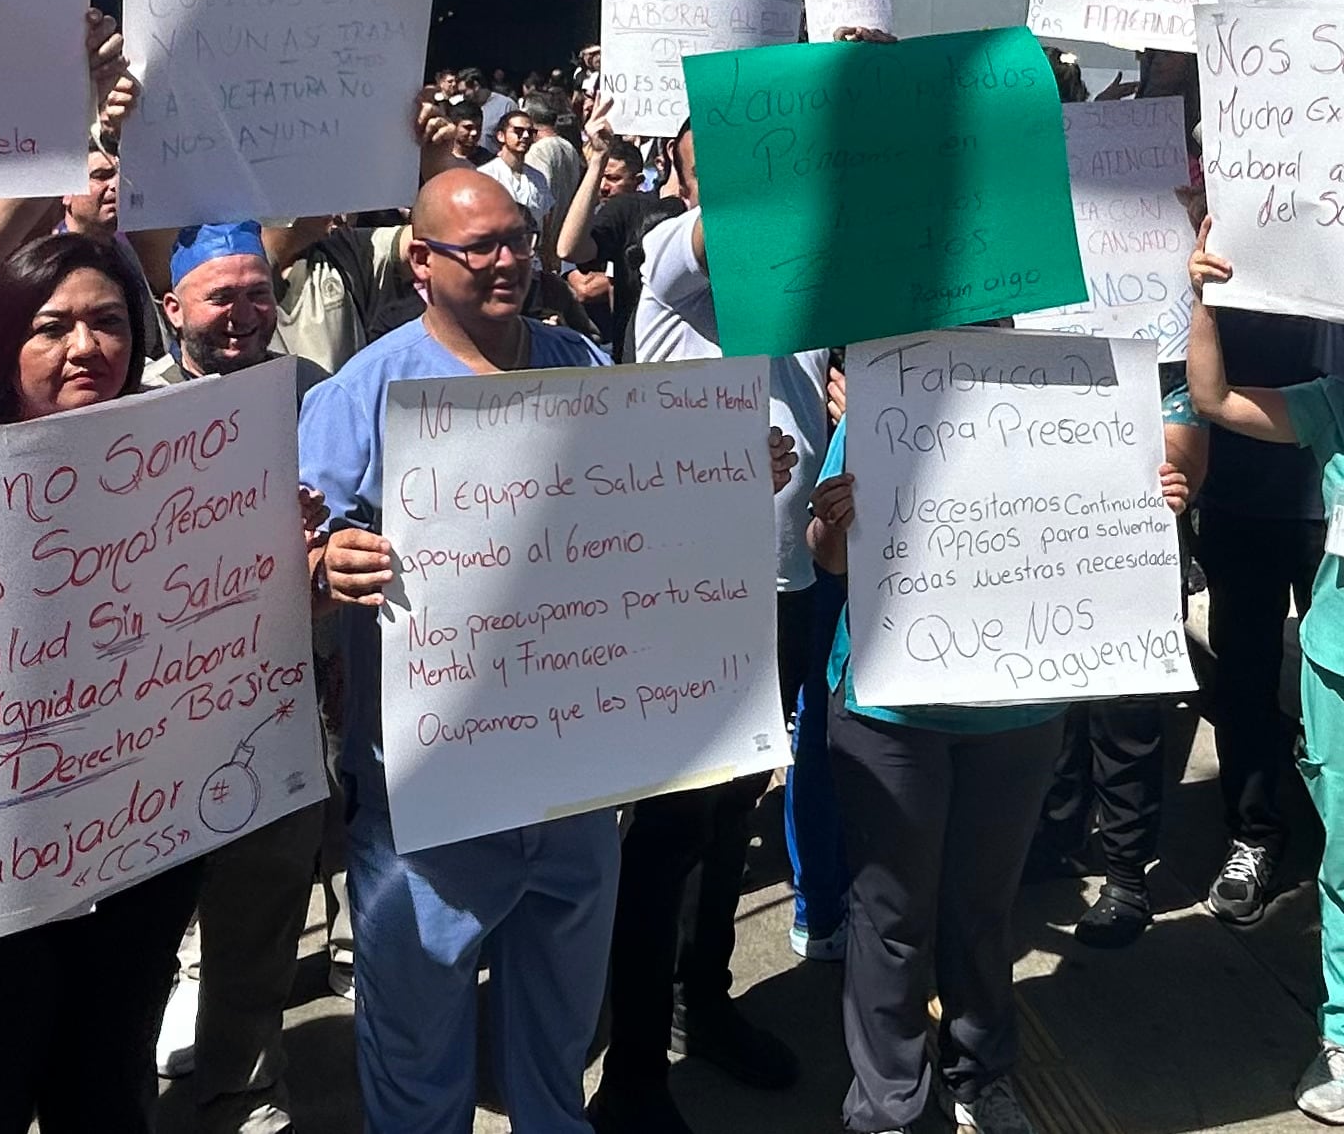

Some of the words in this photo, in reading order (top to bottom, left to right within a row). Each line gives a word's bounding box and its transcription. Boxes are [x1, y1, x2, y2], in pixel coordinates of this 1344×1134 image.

[1204, 16, 1291, 77] Nos
[604, 74, 627, 93] NO
[633, 75, 653, 90] ES
[706, 58, 832, 127] Laura
[1208, 146, 1303, 182] Laboral
[1256, 185, 1298, 228] del
[1088, 230, 1180, 255] CANSADO
[867, 340, 1048, 397] Fabrica
[1062, 354, 1115, 397] De
[419, 385, 453, 440] No
[657, 380, 709, 411] Salud
[875, 407, 977, 461] Ropa
[987, 402, 1137, 448] Presente
[2, 465, 78, 523] no
[98, 408, 241, 494] Somos
[401, 465, 440, 521] El
[544, 461, 577, 497] de
[583, 464, 665, 497] Salud
[677, 449, 758, 487] Mental
[31, 528, 158, 598] Somos
[156, 470, 269, 547] Personal
[887, 485, 1062, 528] Necesitamos
[401, 539, 512, 582] apoyando
[528, 529, 552, 563] al
[882, 536, 909, 562] de
[927, 524, 1022, 561] PAGOS
[1040, 525, 1090, 554] para
[1096, 520, 1172, 538] solventar
[88, 601, 144, 649] Sin
[157, 555, 276, 622] Salario
[877, 570, 958, 599] Todas
[1076, 551, 1179, 575] necesidades
[408, 612, 458, 651] Nos
[469, 599, 609, 645] preocupamos
[622, 590, 661, 619] por
[665, 577, 691, 603] tu
[694, 579, 749, 605] Salud
[1025, 598, 1095, 650] NOS
[135, 614, 262, 701] Laboral
[409, 654, 477, 690] Mental
[995, 637, 1134, 689] Paguen
[417, 712, 538, 747] Ocupamos
[548, 703, 585, 740] que
[595, 686, 626, 713] les
